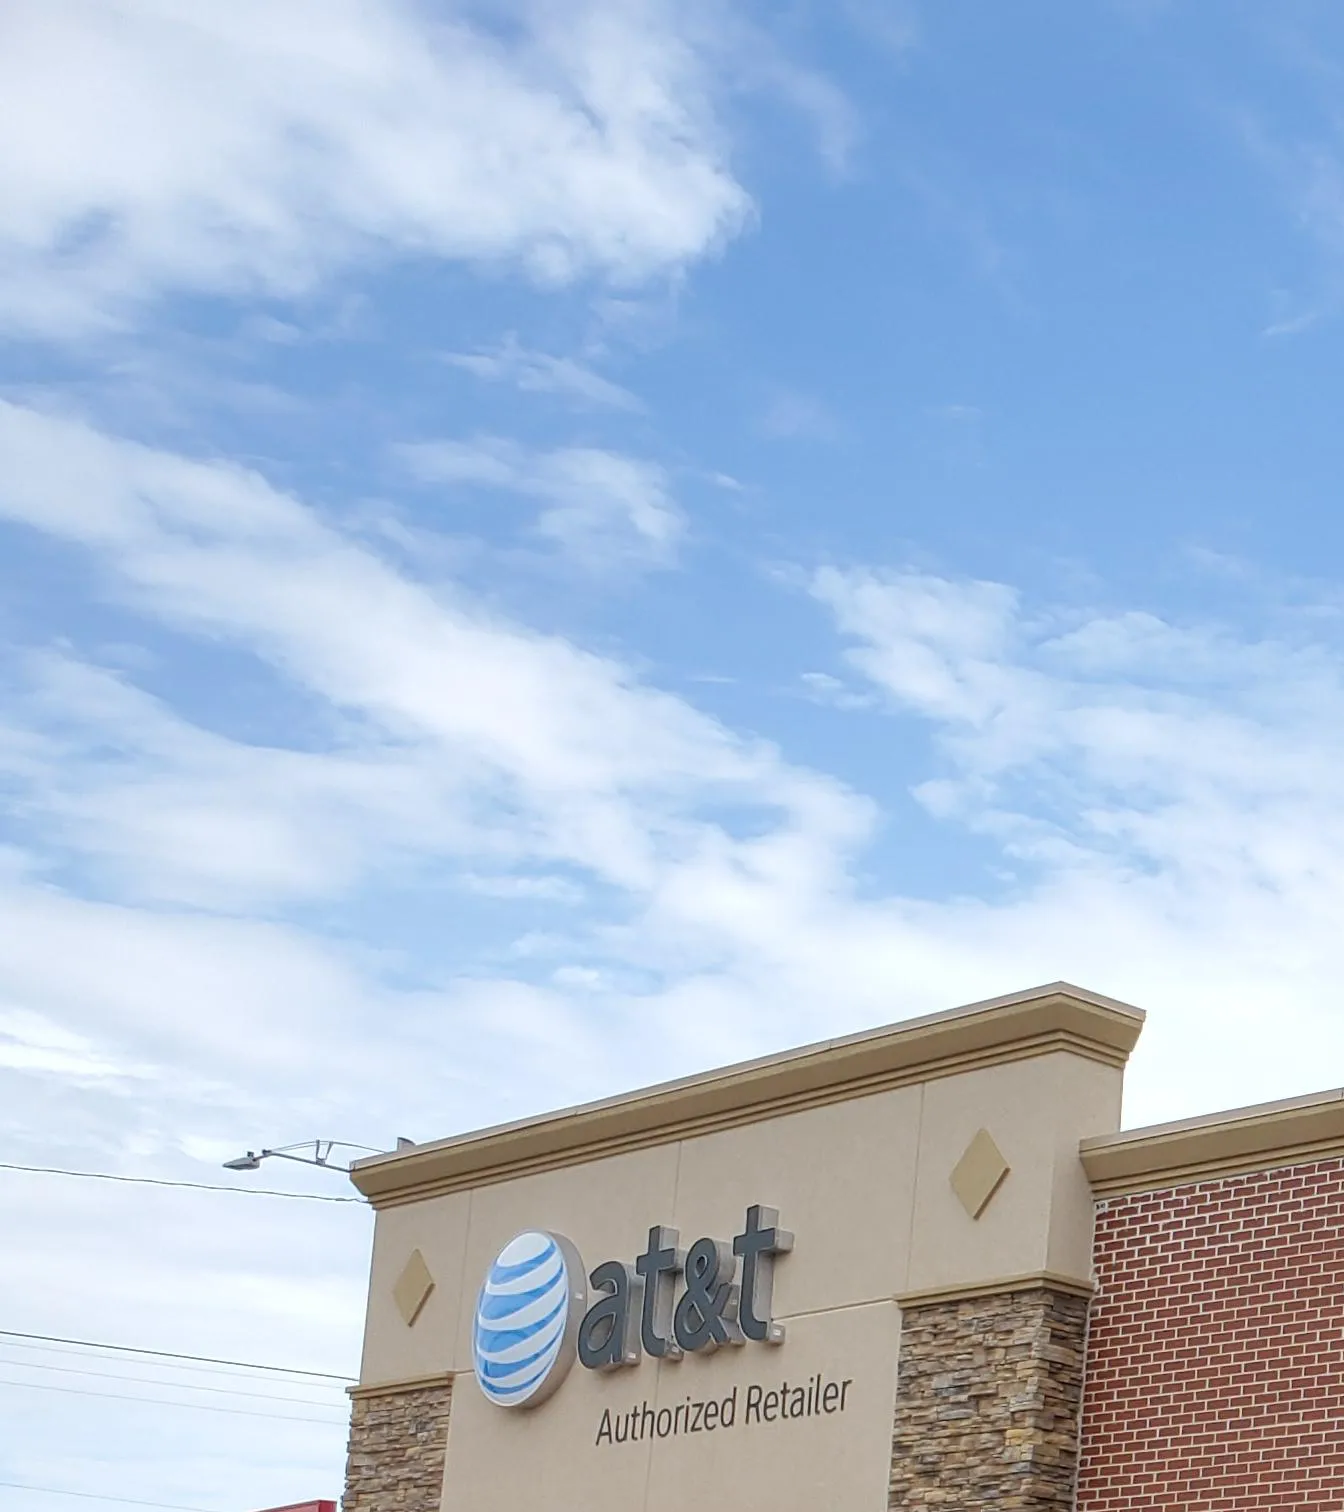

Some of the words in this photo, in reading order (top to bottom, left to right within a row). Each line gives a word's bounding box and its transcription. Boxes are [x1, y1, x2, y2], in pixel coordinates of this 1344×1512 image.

[577, 1203, 795, 1374] at&t
[594, 1386, 738, 1446] Authorized
[745, 1373, 853, 1425] Retailer
